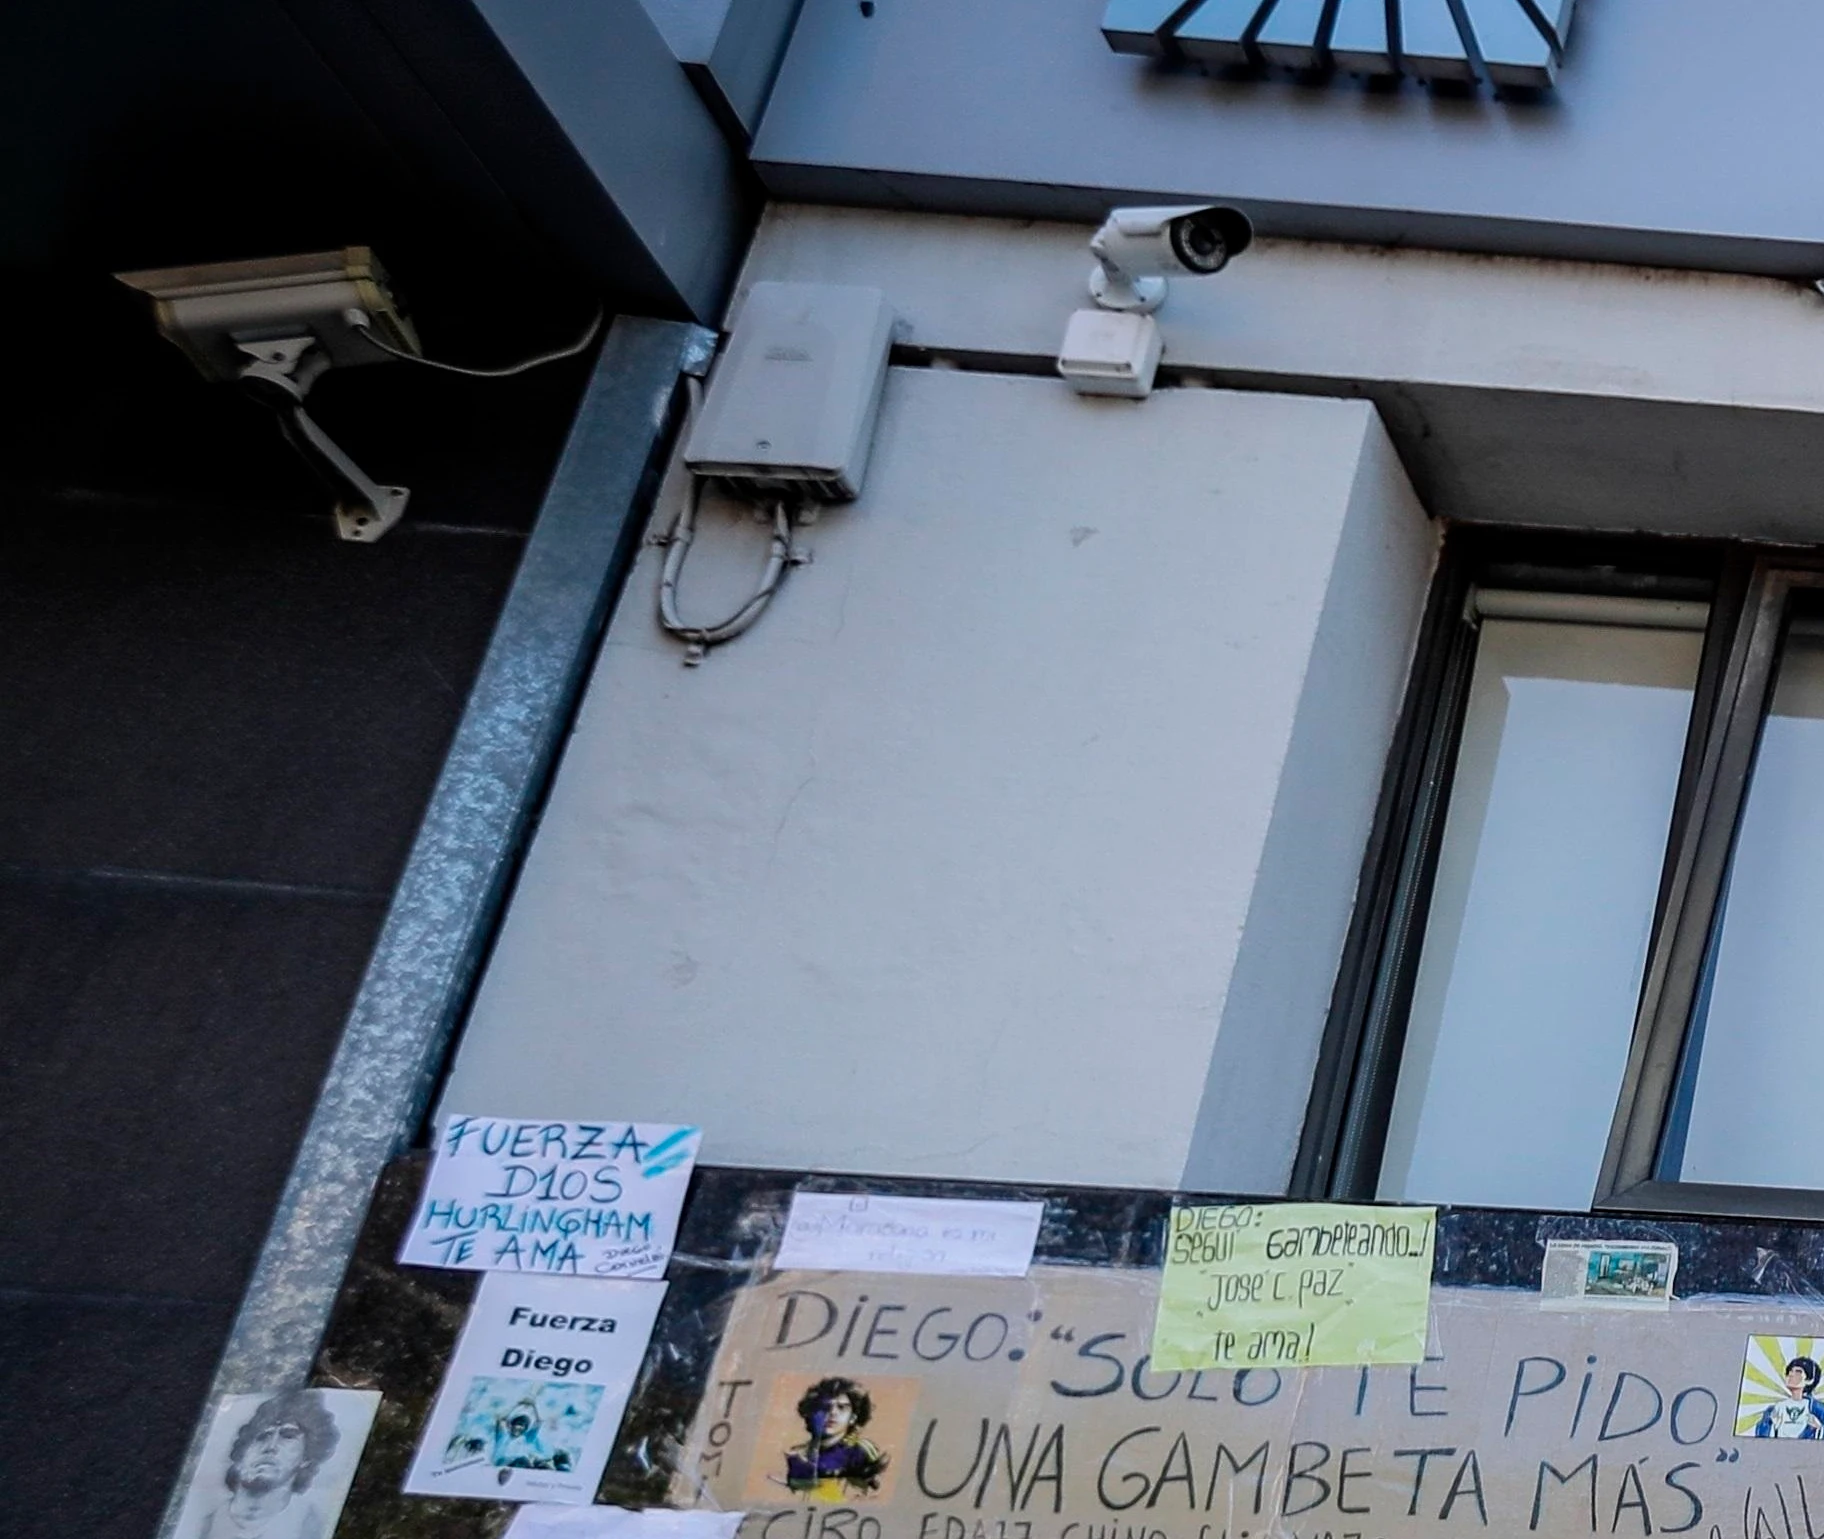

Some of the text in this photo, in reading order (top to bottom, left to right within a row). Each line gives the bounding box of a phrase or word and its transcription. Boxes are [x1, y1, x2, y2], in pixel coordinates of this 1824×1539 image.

[448, 1119, 650, 1166] FUERZA
[432, 1238, 584, 1273] TE AMA
[508, 1306, 617, 1334] Fuerza
[500, 1346, 593, 1378] Diego
[916, 1417, 1067, 1515] UNA
[1097, 1425, 1488, 1528] GAMBETA
